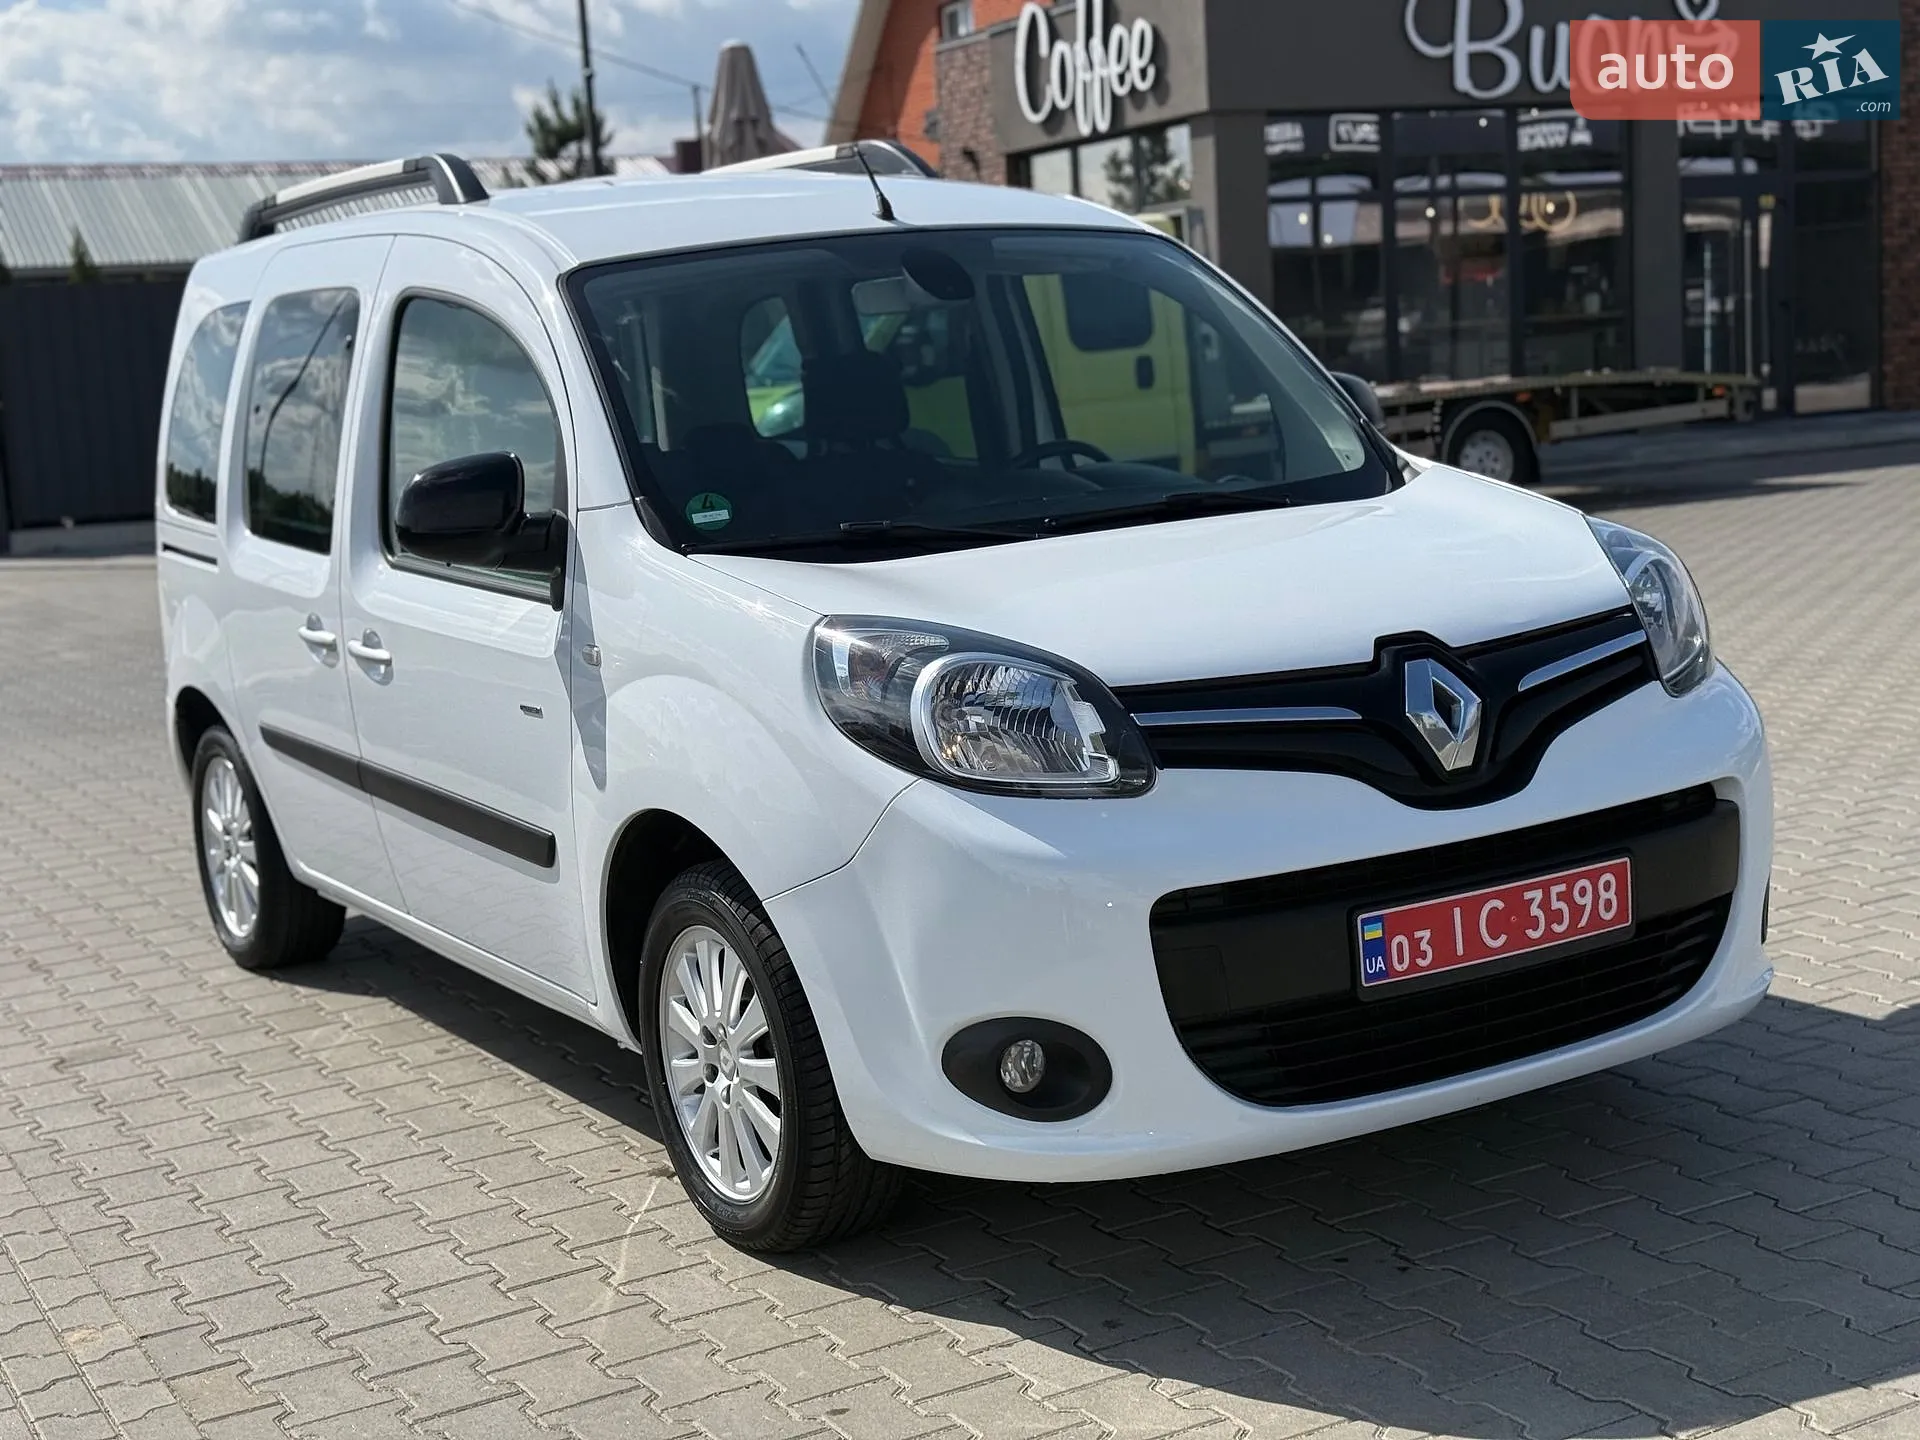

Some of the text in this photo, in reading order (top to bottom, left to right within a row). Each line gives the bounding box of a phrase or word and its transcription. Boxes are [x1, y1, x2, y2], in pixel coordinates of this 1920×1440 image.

[1014, 0, 1156, 137] Coffee
[1365, 955, 1386, 974] UA
[1390, 872, 1618, 972] 03 IC 3598
